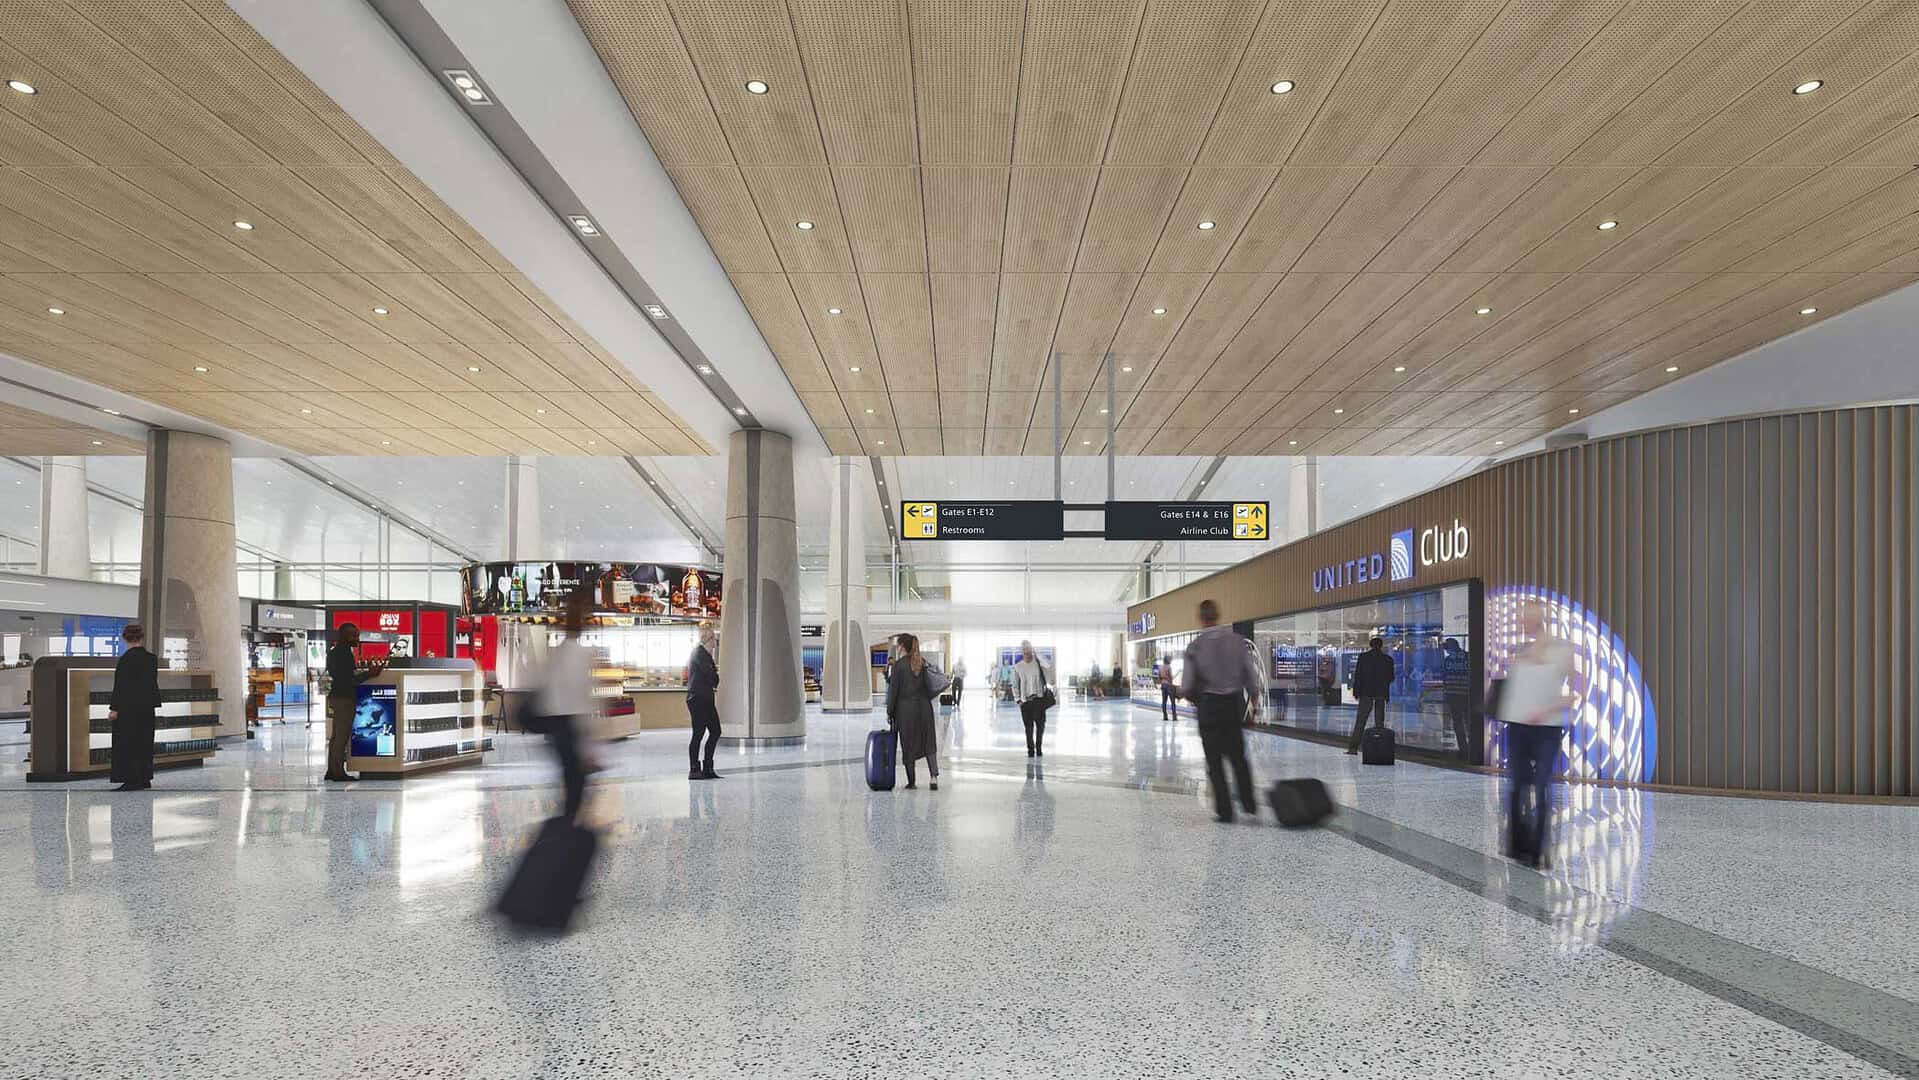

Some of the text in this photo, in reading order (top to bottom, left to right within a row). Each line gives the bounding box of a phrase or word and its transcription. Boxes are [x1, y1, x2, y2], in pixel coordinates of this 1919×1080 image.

[941, 508, 995, 516] Gates E1-E12
[1160, 510, 1229, 519] Gates E14 & E16
[942, 526, 985, 534] Restrooms
[1180, 527, 1229, 535] Airline Club
[1313, 519, 1469, 593] UNITED Club
[379, 618, 399, 626] BOX
